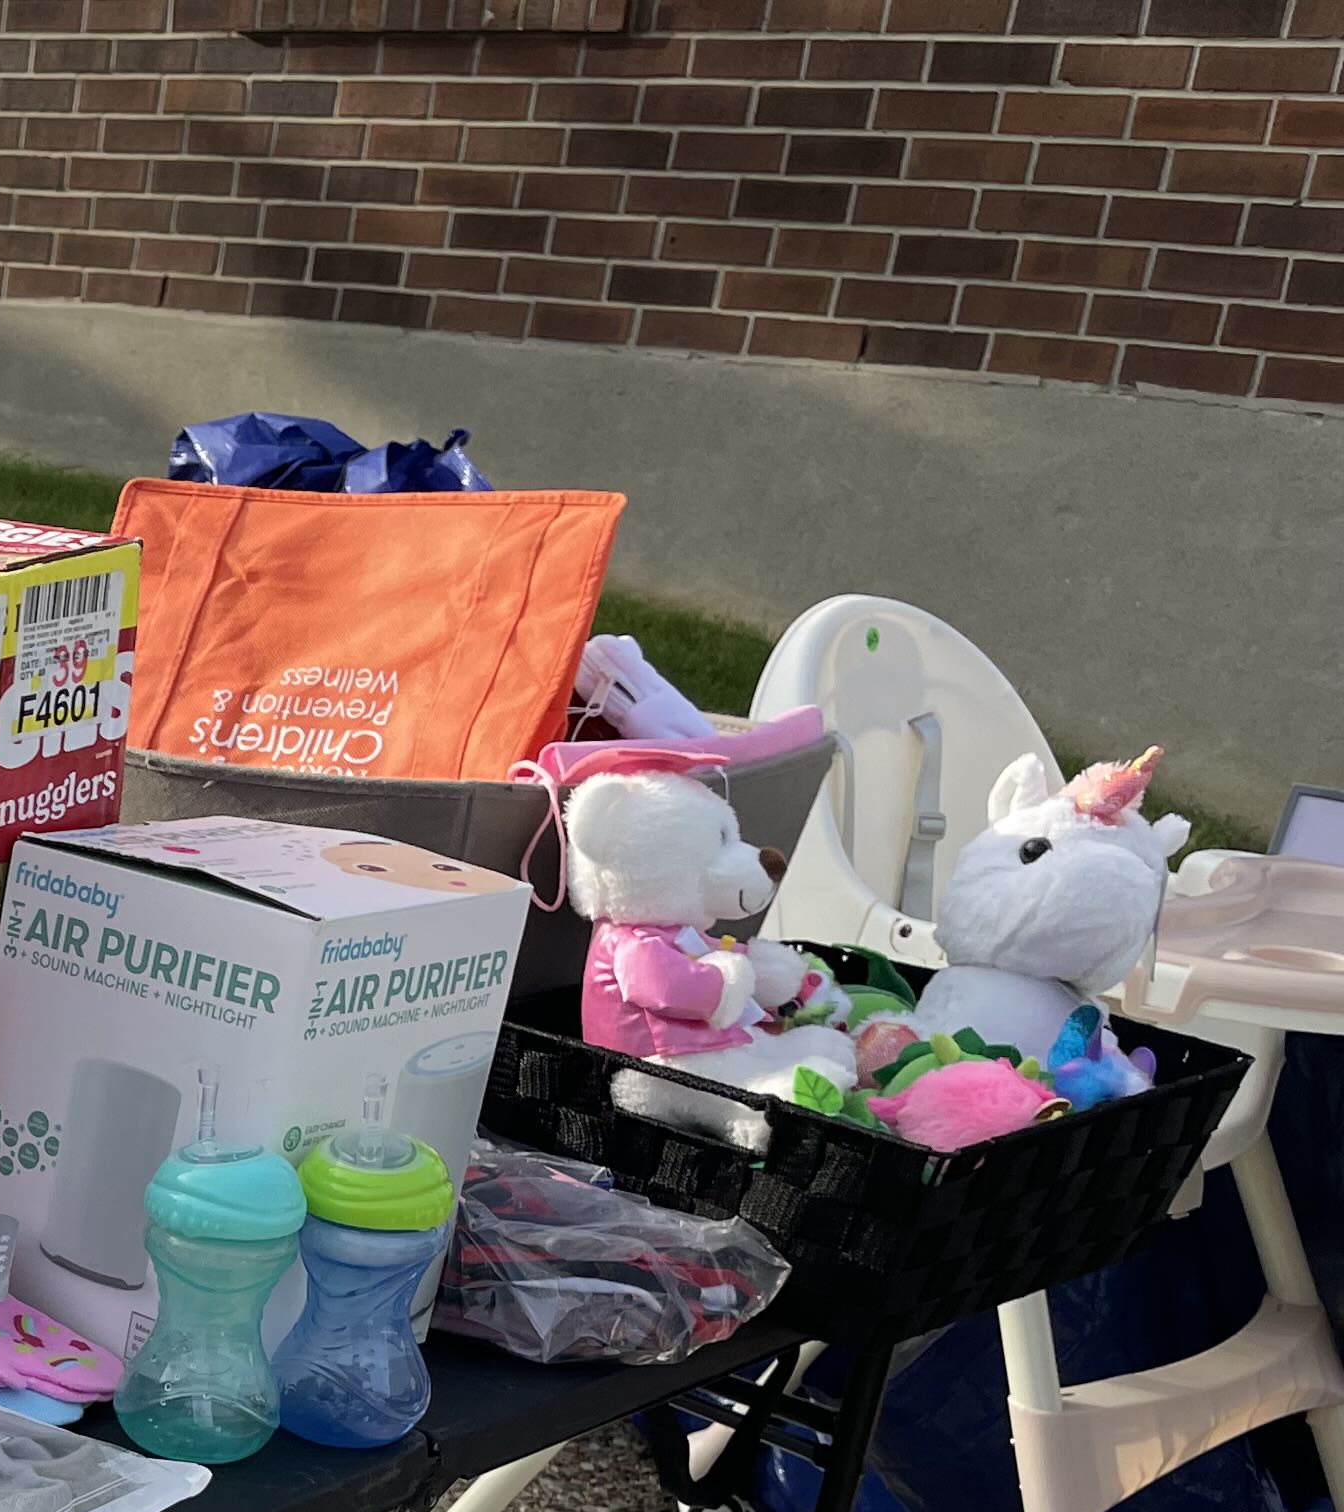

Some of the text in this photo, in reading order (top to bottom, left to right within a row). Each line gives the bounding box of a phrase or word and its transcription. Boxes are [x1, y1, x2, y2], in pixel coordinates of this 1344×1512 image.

[52, 639, 88, 687] 39
[279, 667, 399, 694] Wellness
[17, 681, 100, 734] F4601
[212, 689, 393, 726] Prevention &
[188, 716, 383, 764] Children's
[16, 862, 119, 918] fridababy
[4, 900, 26, 958] 3-IN-1
[320, 933, 405, 965] fridababy
[25, 908, 281, 1013] AIR PURIFIER
[323, 950, 508, 1018] AIR PURIFIER
[30, 950, 80, 980] SOUND
[83, 965, 149, 999] MACHINE
[165, 991, 257, 1031] NIGHTLIGHT
[303, 980, 329, 1041] 3-IN-1
[328, 1015, 369, 1038] SOUND
[372, 1008, 420, 1031] MACHINE
[431, 993, 490, 1019] NIGHTLIGHT
